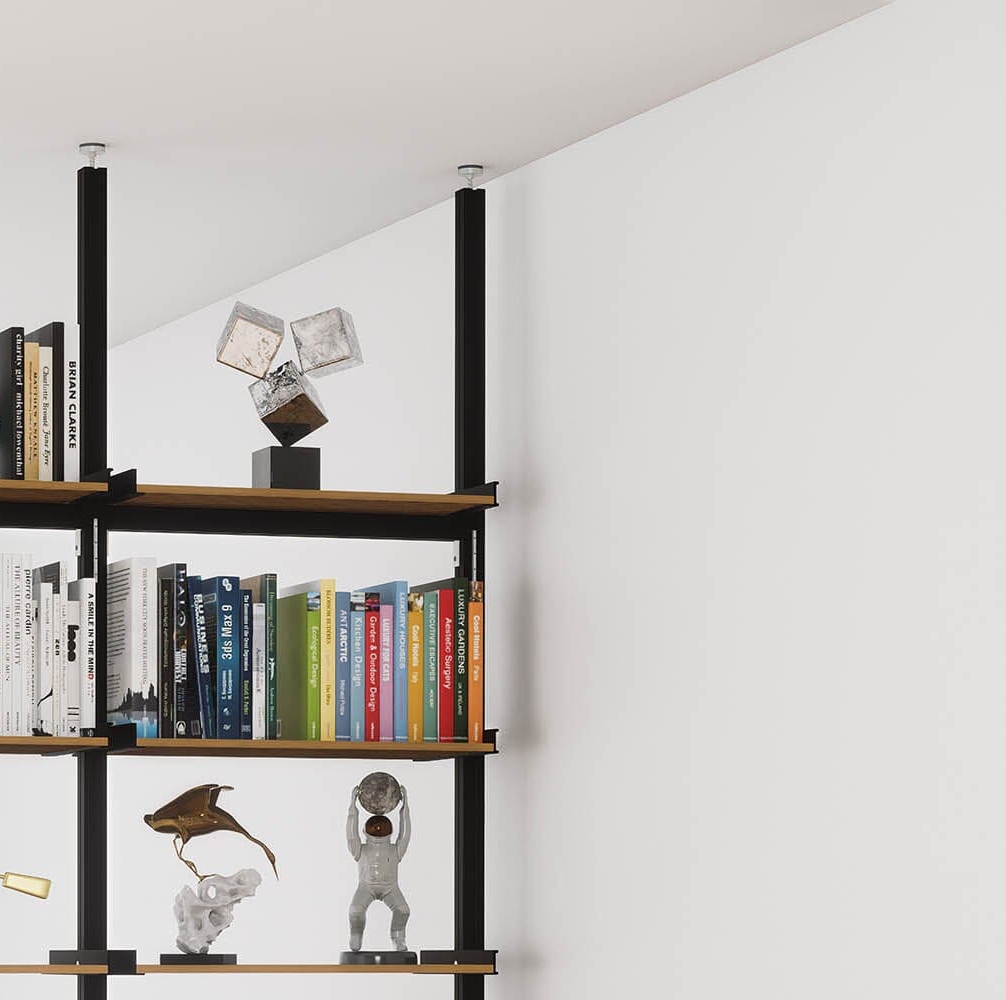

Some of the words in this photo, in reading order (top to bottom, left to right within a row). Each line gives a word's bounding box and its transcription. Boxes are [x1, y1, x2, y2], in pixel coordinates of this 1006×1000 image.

[14, 333, 24, 367] charity
[14, 369, 24, 386] girl
[42, 366, 50, 400] Charlotte
[69, 361, 77, 400] BRIAN
[14, 392, 24, 428] michael
[43, 430, 51, 449] Jane
[69, 404, 77, 450] CLARKE
[14, 431, 24, 477] lowenthal
[43, 450, 51, 467] Eyre
[24, 569, 32, 600] pierre
[458, 589, 466, 626] LUXURY
[88, 628, 95, 638] IN
[222, 615, 233, 638] Max
[340, 610, 348, 663] ANTARCTIC
[352, 617, 363, 652] Kitchen
[369, 617, 377, 643] Garden
[412, 625, 421, 641] Cool
[473, 615, 481, 633] Cool
[222, 641, 233, 661] 3ds
[310, 626, 319, 662] Ecological
[412, 643, 421, 667] Hotels
[458, 628, 466, 675] GARDENS
[473, 634, 481, 661] Hotels
[310, 663, 319, 689] Design
[352, 655, 363, 687] Design
[369, 653, 377, 685] Outdoor
[443, 655, 453, 690] Surgery
[369, 687, 377, 712] Design
